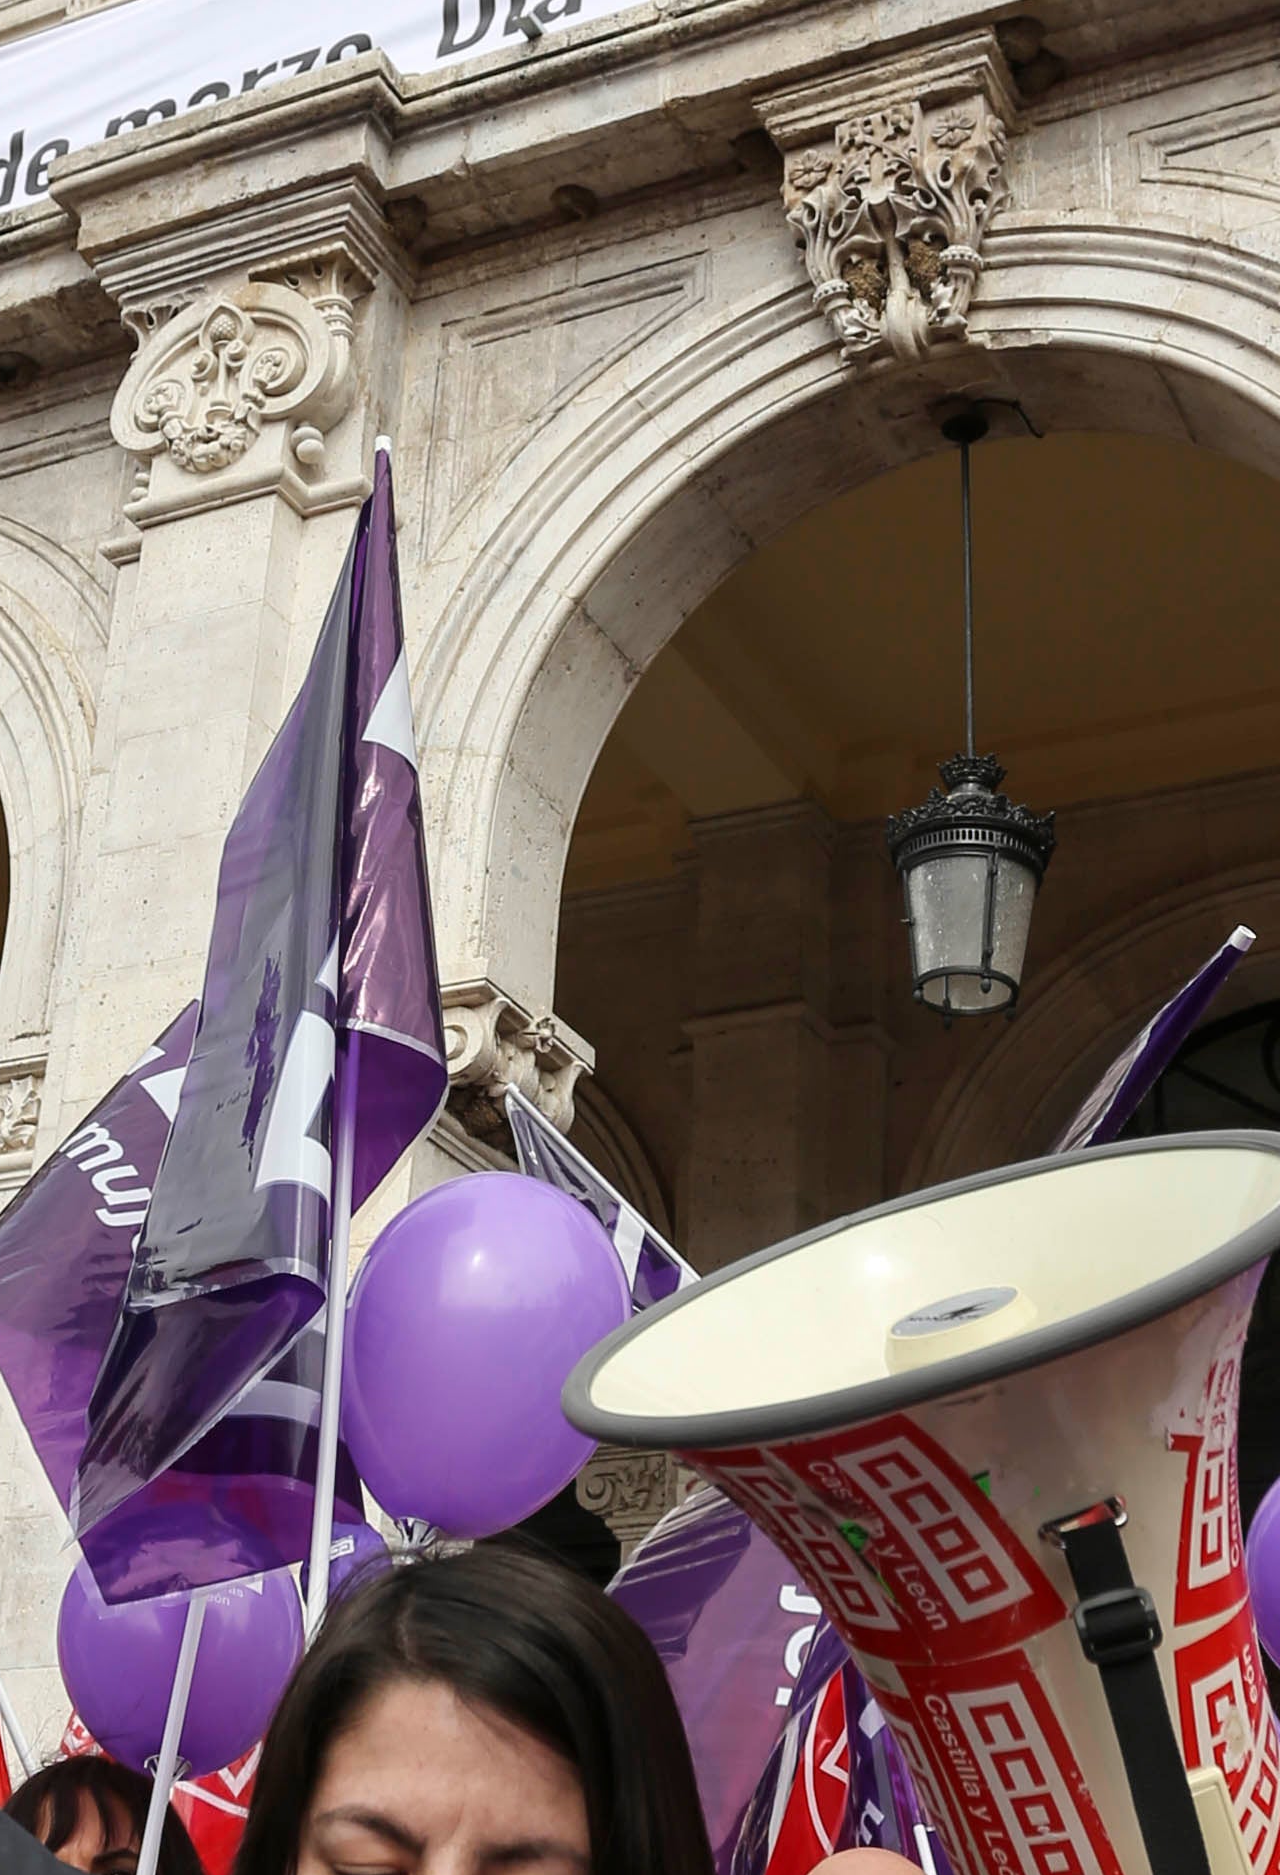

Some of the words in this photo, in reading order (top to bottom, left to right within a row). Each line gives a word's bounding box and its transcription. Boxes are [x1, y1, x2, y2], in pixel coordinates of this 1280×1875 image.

[732, 1472, 880, 1619] CCOO
[856, 1447, 1012, 1607] CCOO
[896, 1562, 949, 1632] León
[923, 1694, 982, 1798] Castilla
[968, 1804, 993, 1823] y
